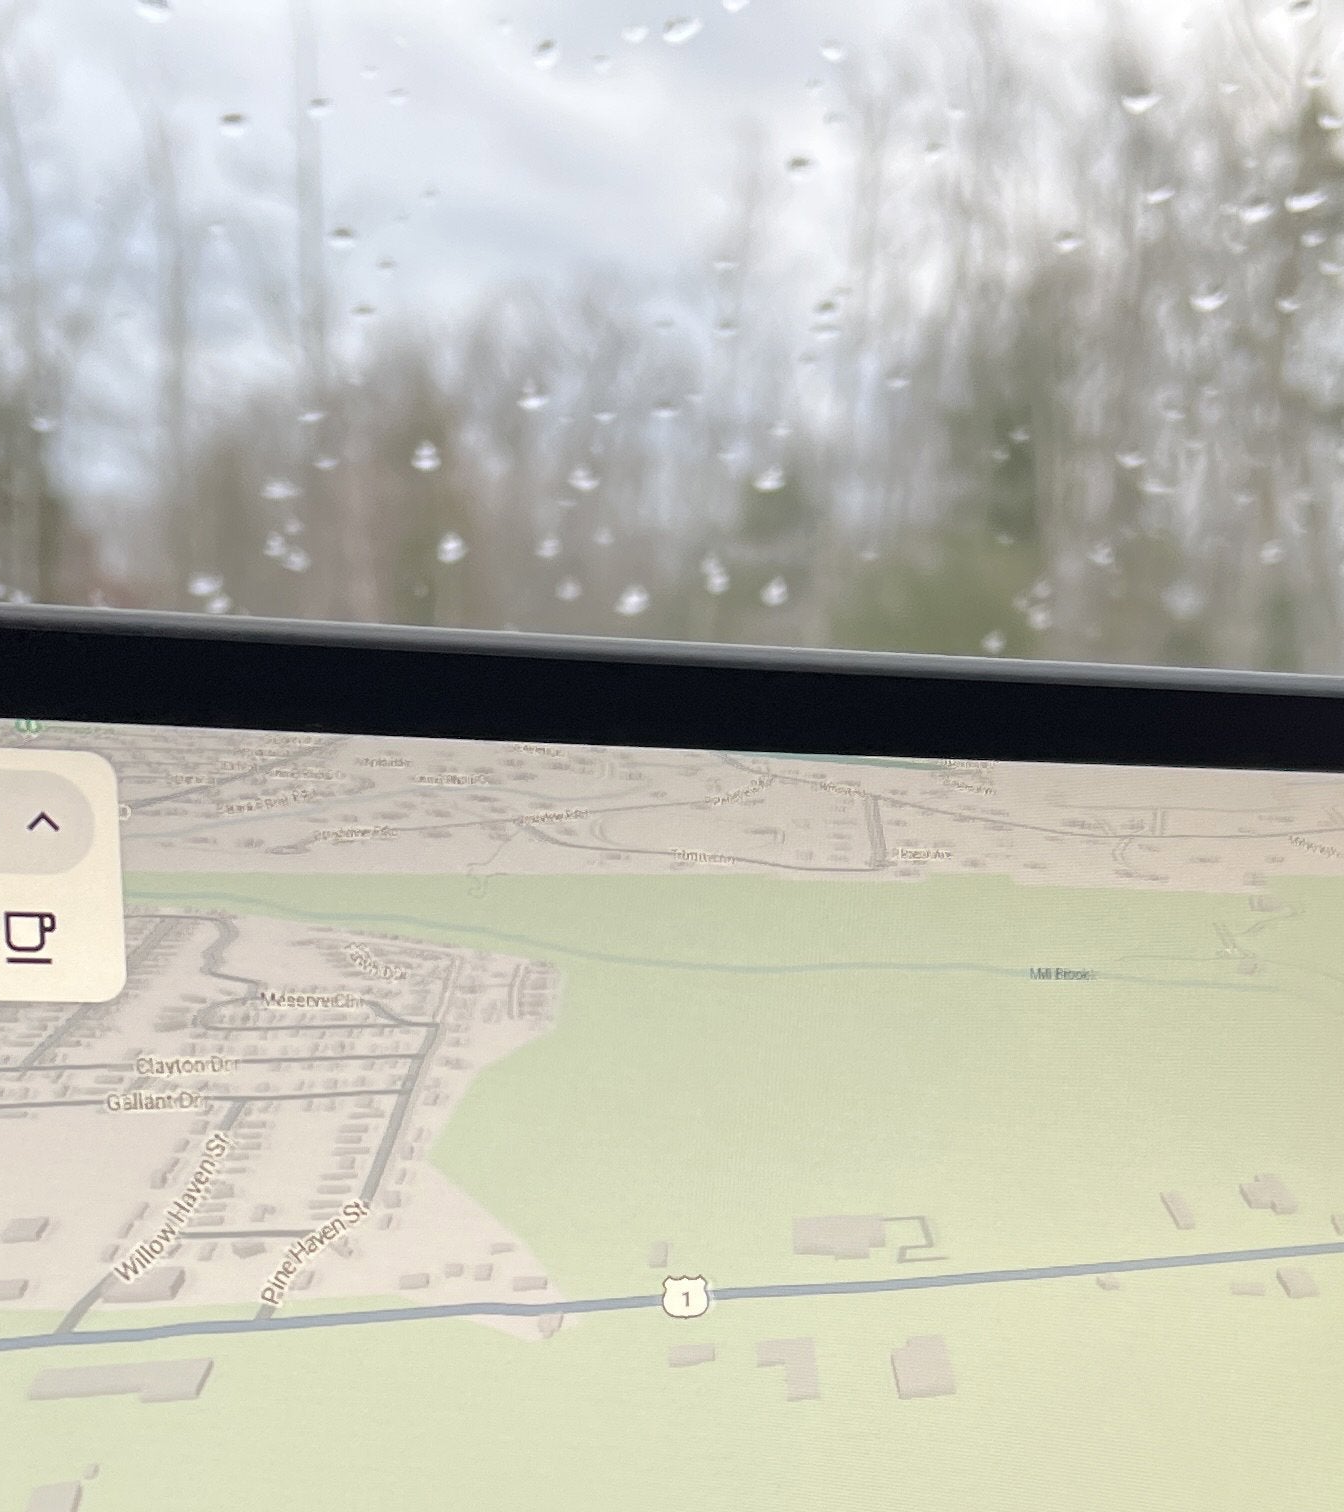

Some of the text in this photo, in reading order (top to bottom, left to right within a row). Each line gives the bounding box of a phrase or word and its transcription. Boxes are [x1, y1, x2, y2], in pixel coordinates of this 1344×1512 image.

[137, 1057, 206, 1078] Clayton
[113, 1132, 230, 1282] Willow Haven St
[260, 1200, 370, 1305] Pine Haven St
[681, 1291, 690, 1307] 1
